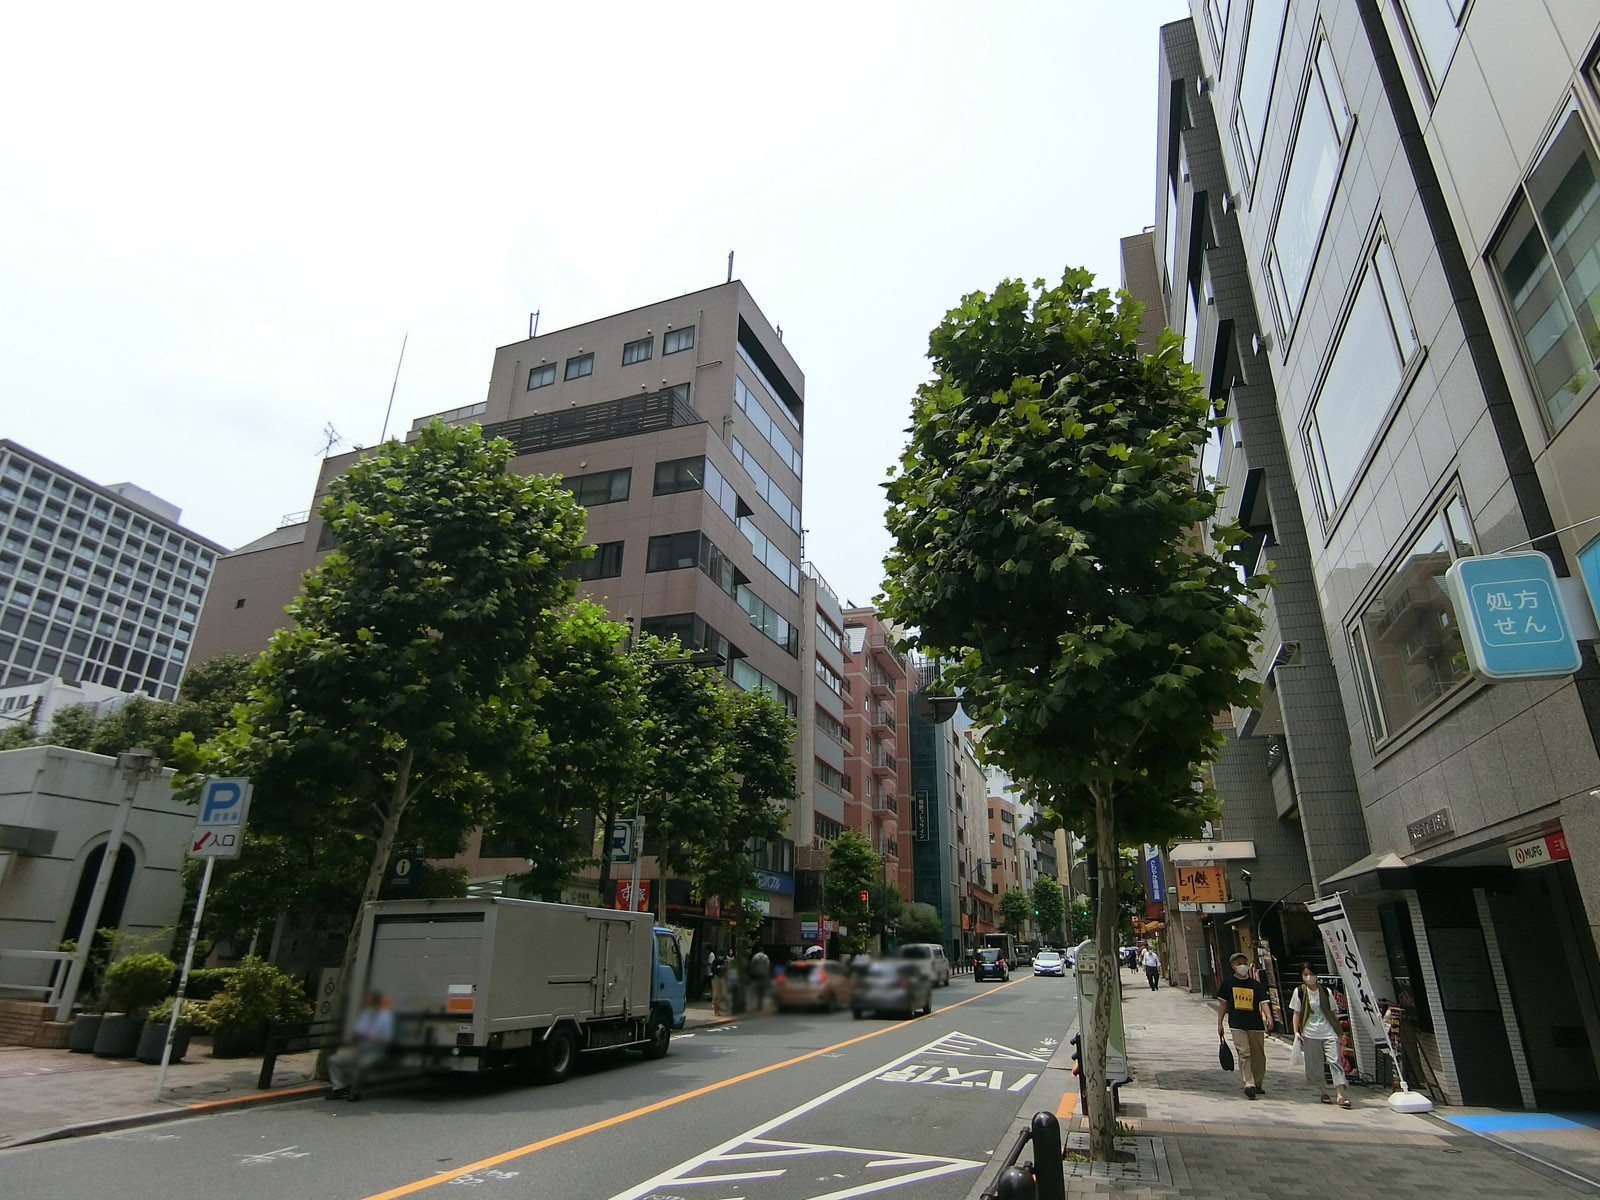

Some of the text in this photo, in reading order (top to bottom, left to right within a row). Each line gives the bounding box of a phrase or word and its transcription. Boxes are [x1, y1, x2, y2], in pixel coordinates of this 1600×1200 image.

[1486, 590, 1539, 612] 処方
[1494, 615, 1547, 635] せん
[203, 783, 240, 821] P
[208, 833, 235, 848] 入口
[1525, 845, 1542, 859] MUFG
[1178, 868, 1210, 895] とり鉄
[875, 1064, 1038, 1092] バス停
